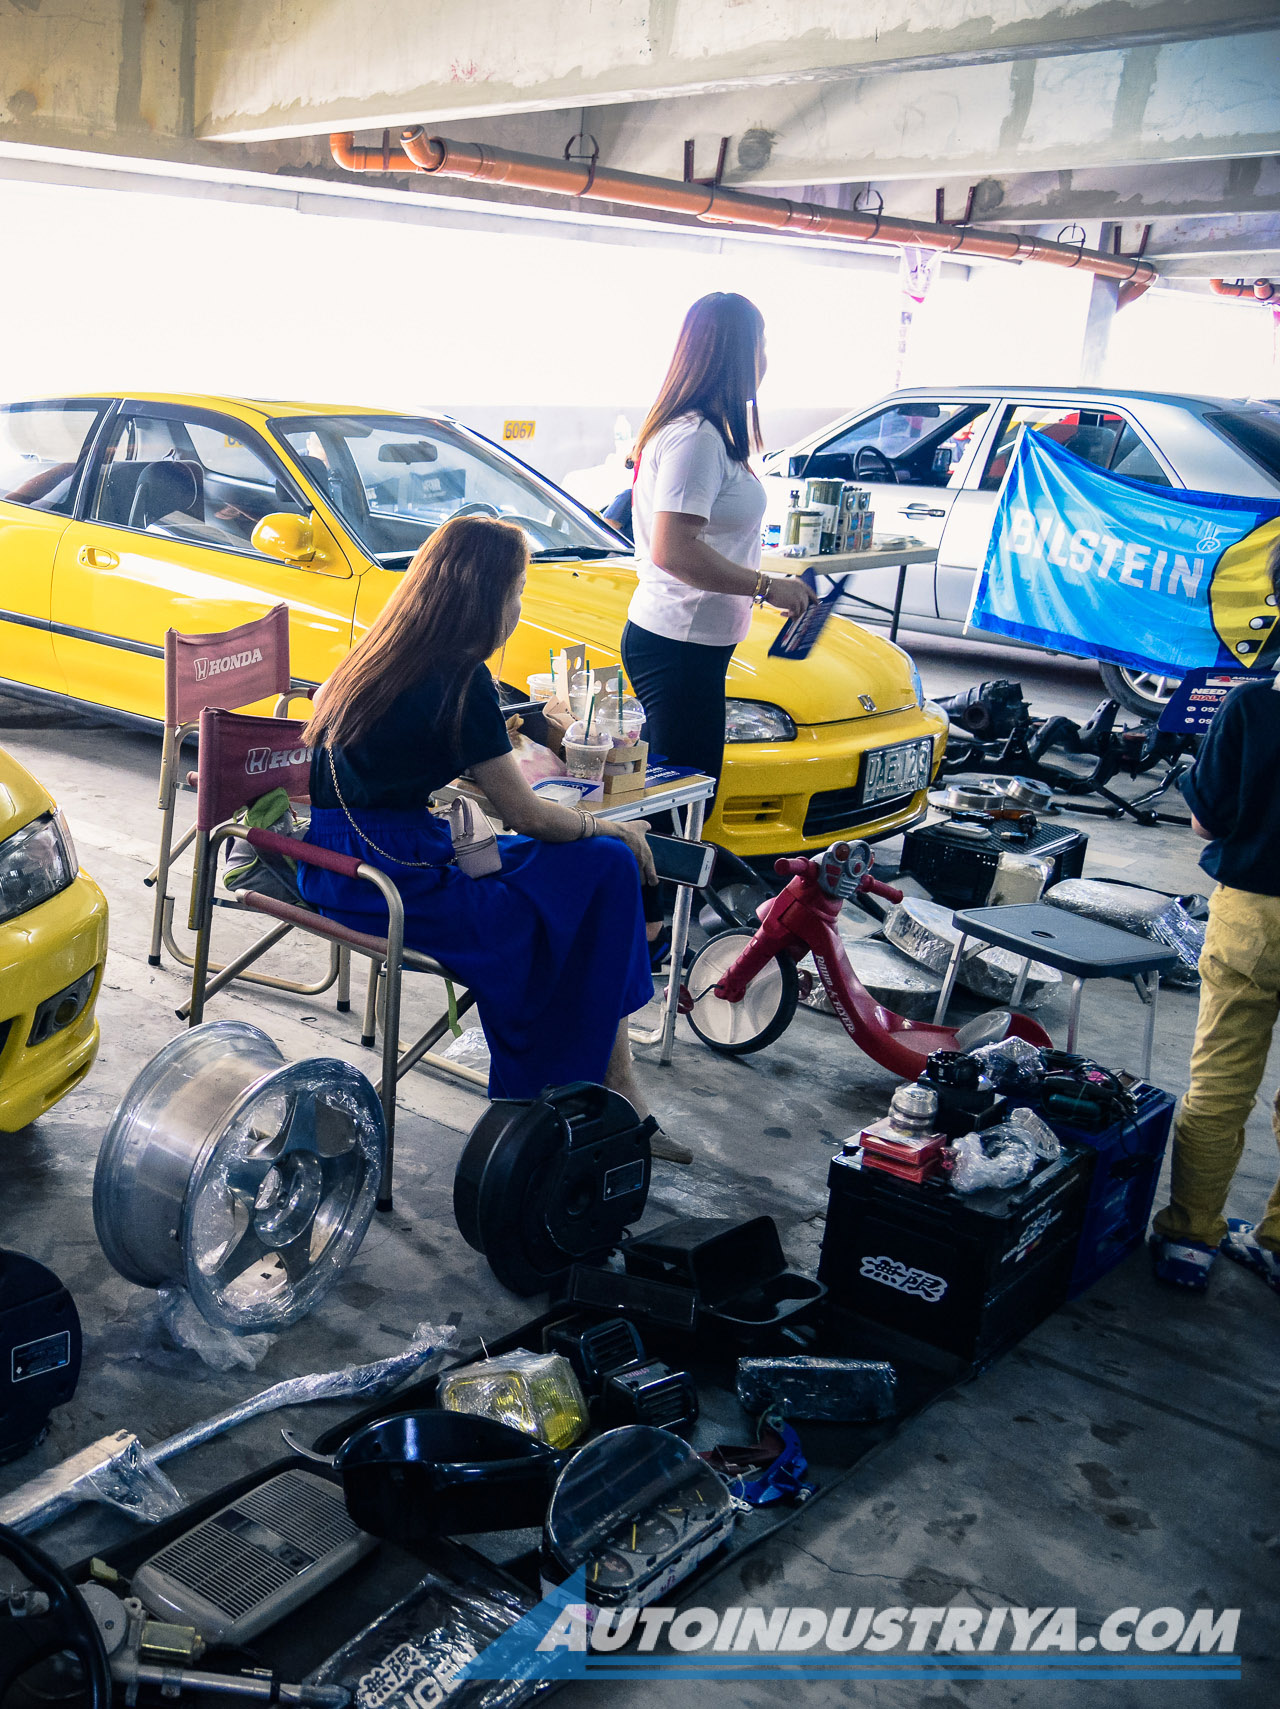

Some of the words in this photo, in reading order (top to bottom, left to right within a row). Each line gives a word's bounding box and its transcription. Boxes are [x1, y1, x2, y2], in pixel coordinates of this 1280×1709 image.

[1009, 509, 1204, 598] BILSTEIN
[208, 648, 263, 676] HONDA
[1189, 694, 1218, 702] DIAL
[860, 1256, 947, 1302] 無限
